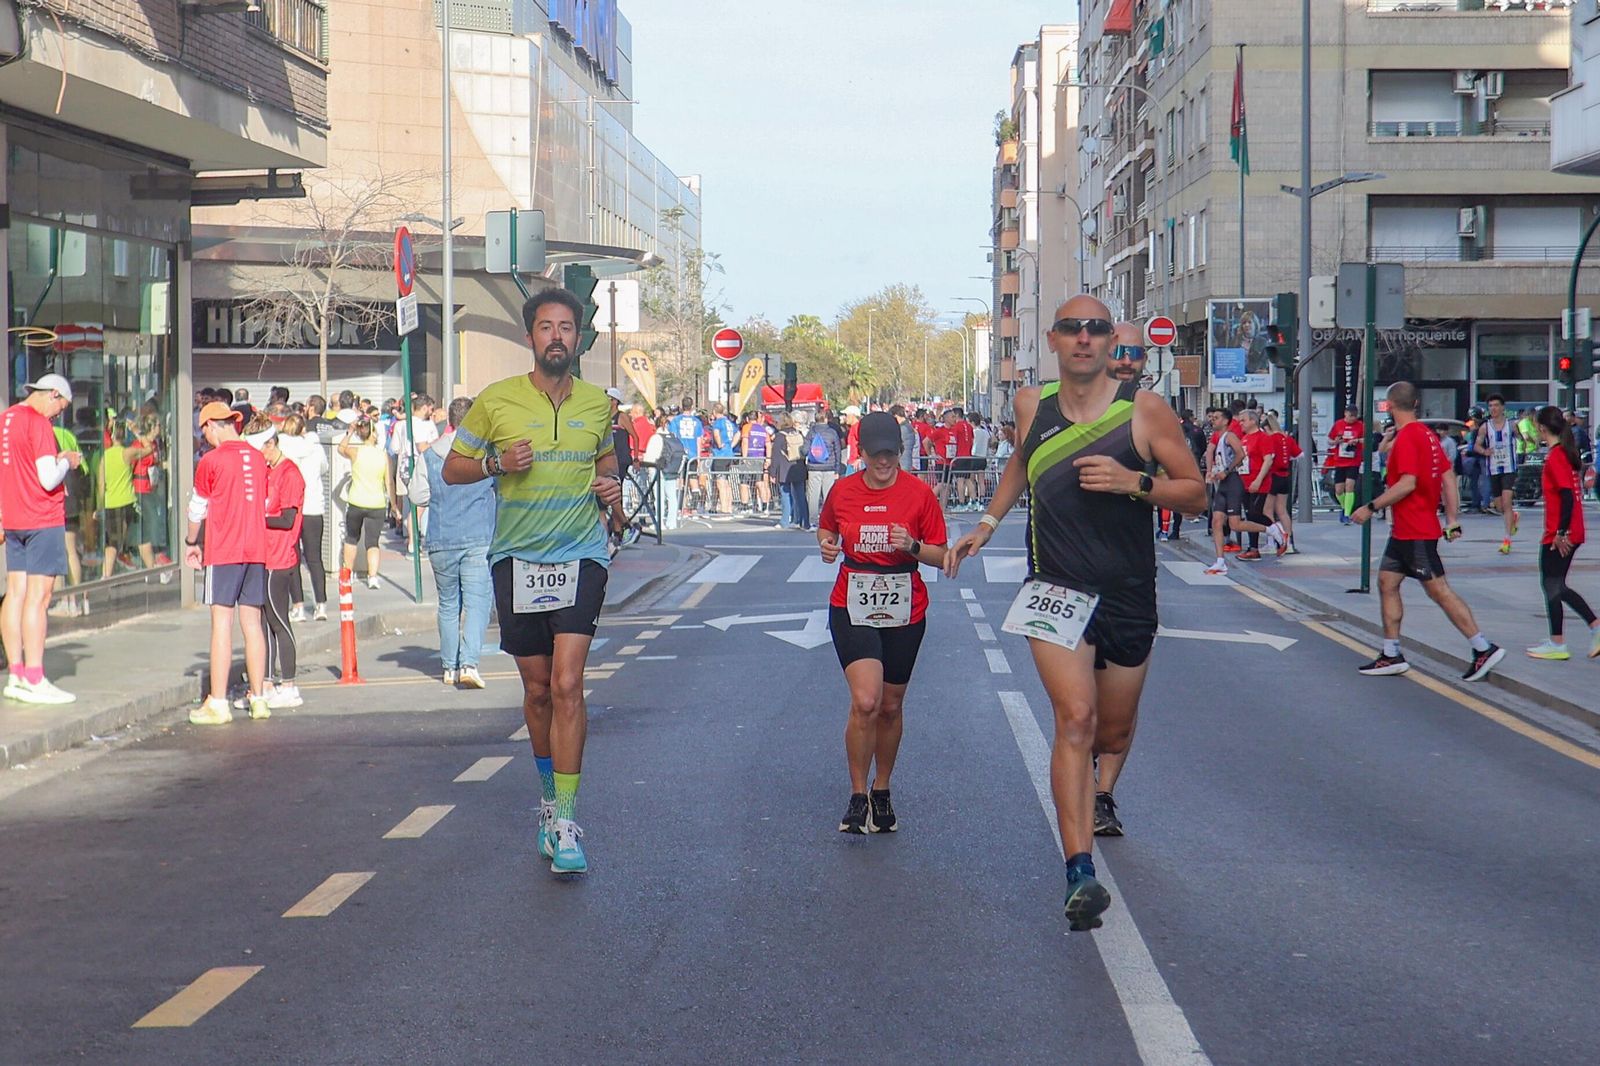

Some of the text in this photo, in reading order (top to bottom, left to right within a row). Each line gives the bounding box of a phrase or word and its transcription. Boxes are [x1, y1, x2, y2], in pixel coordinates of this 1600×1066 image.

[859, 525, 888, 533] MEMORIAL
[859, 532, 889, 544] PADRE
[525, 573, 567, 589] 3109
[859, 592, 900, 606] 3172
[1025, 595, 1076, 619] 2865
